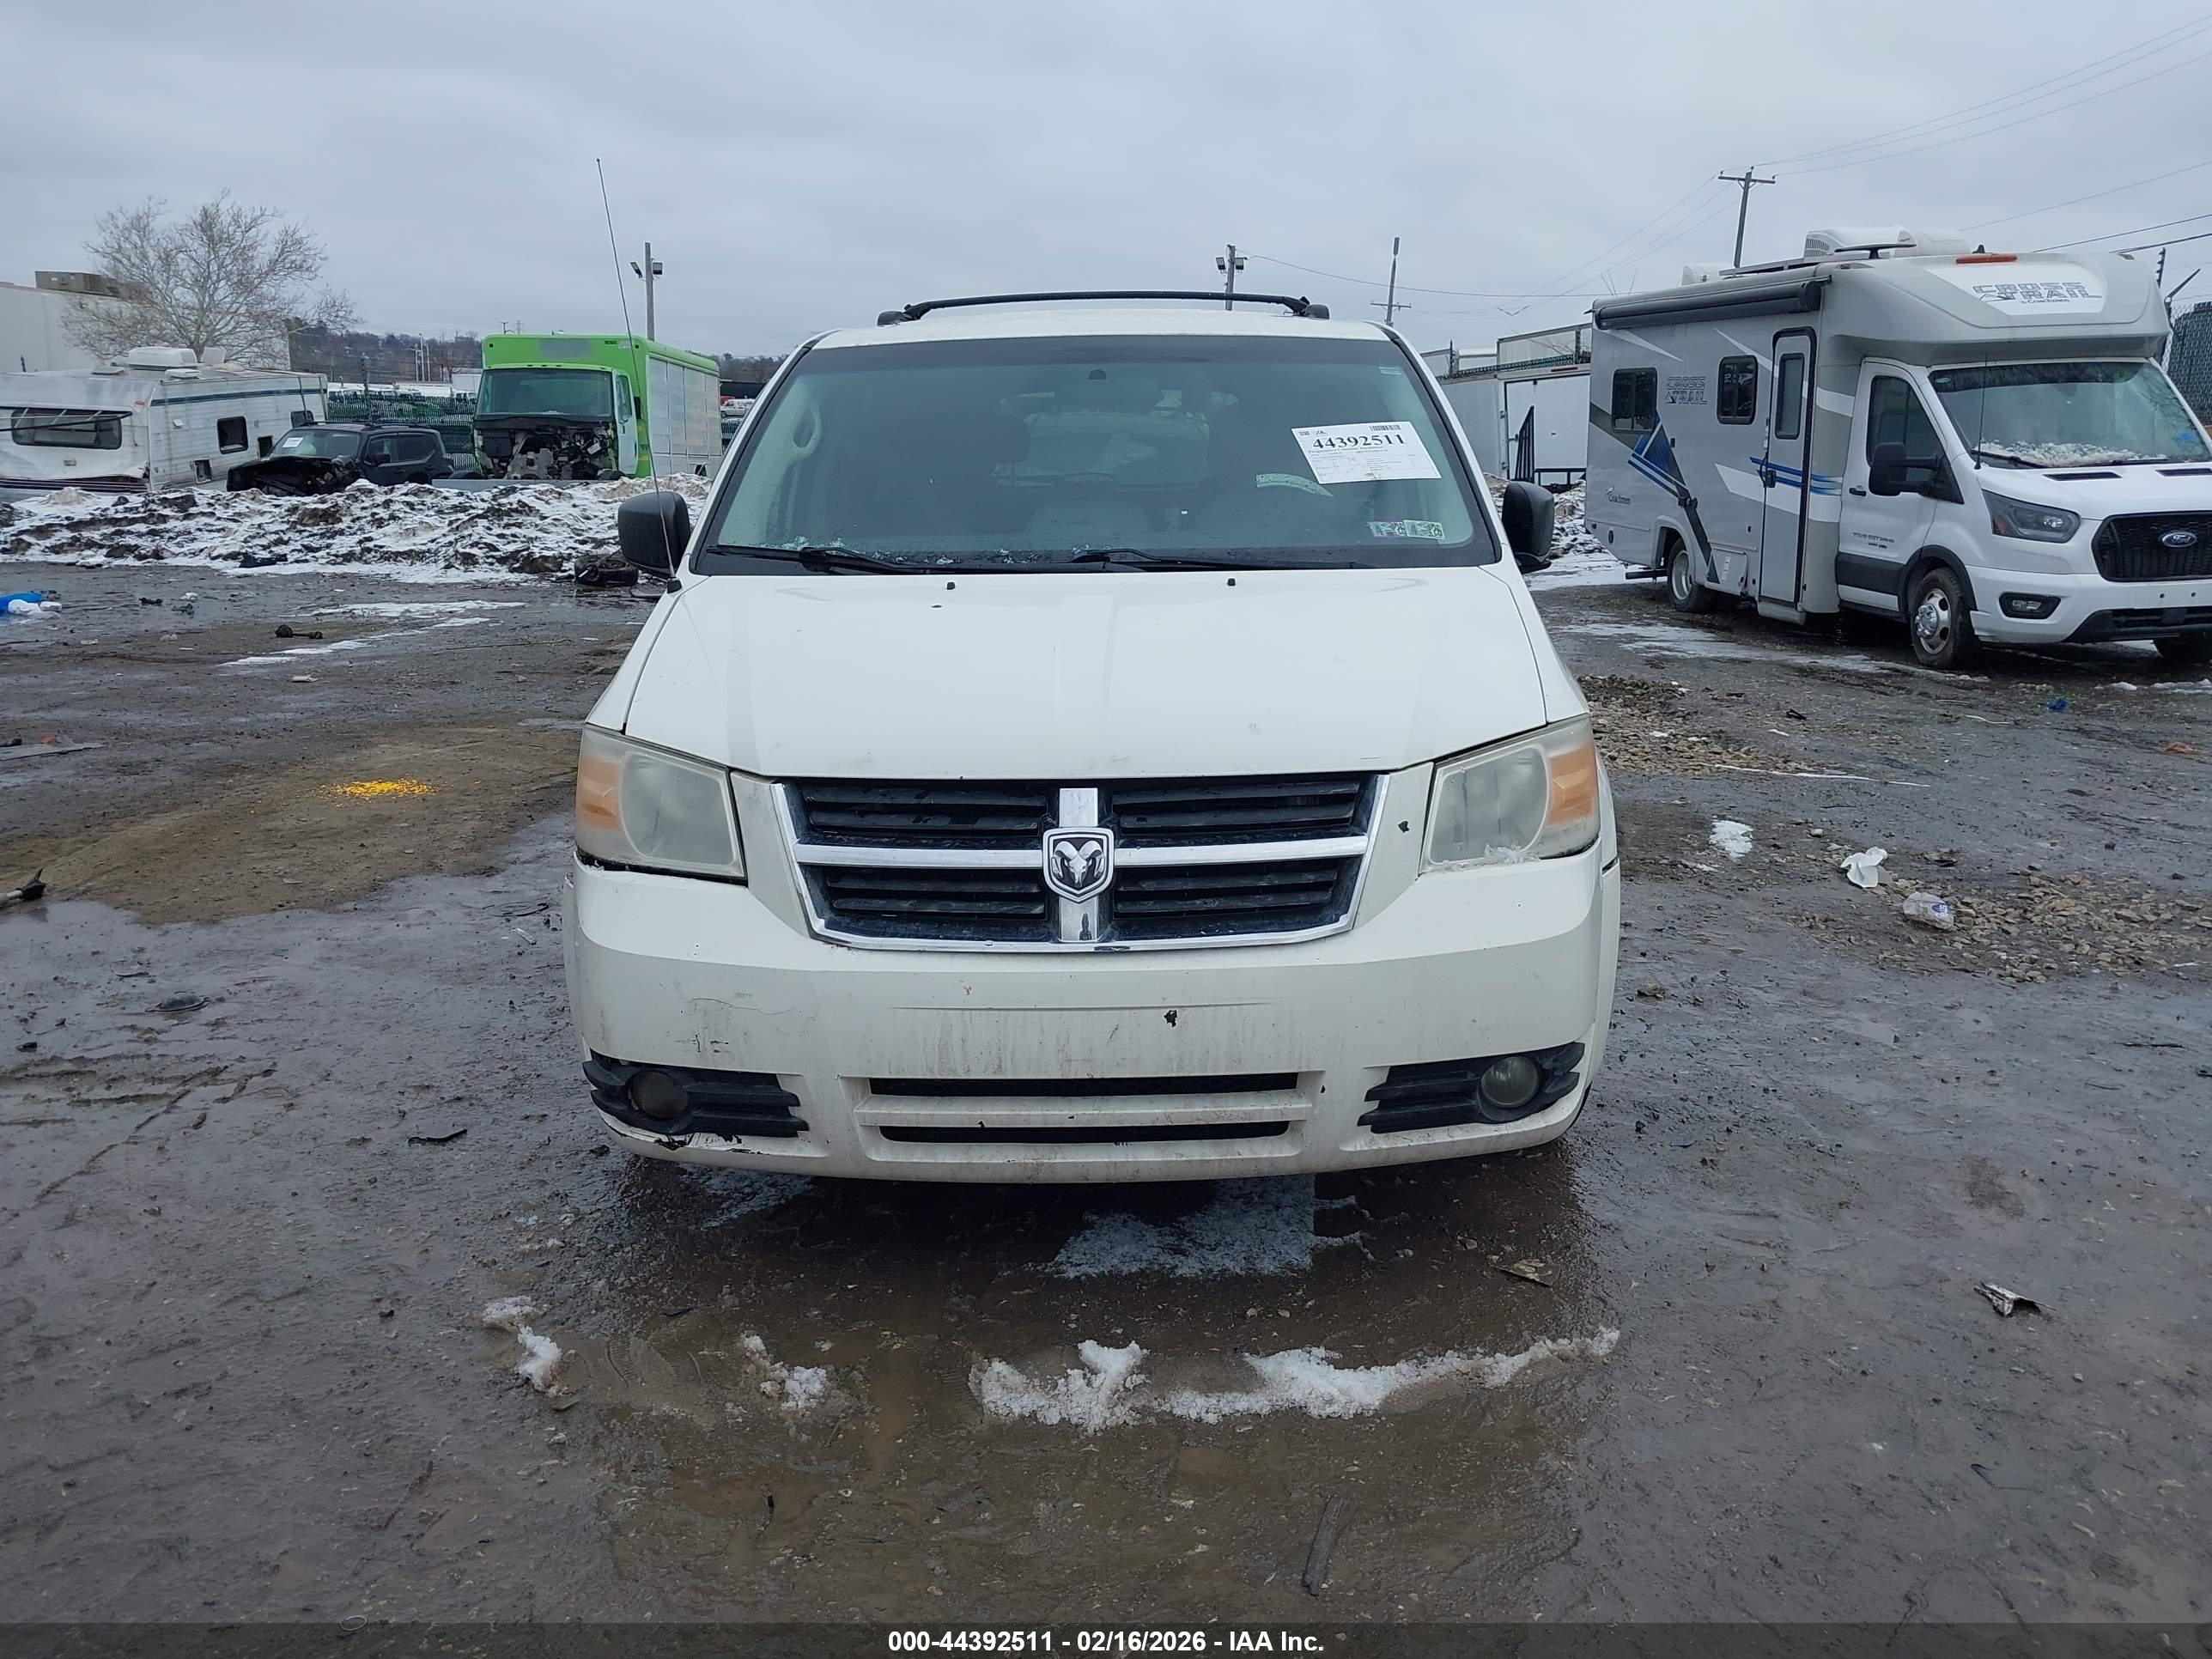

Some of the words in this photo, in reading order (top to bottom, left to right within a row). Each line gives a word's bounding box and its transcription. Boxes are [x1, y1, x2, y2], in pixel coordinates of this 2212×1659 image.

[1972, 283, 2085, 294] CROSS
[1997, 289, 2103, 301] TRAIL
[1666, 376, 1706, 391] CROSS
[1672, 391, 1708, 405] TRAIL
[1313, 434, 1406, 449] 44392511
